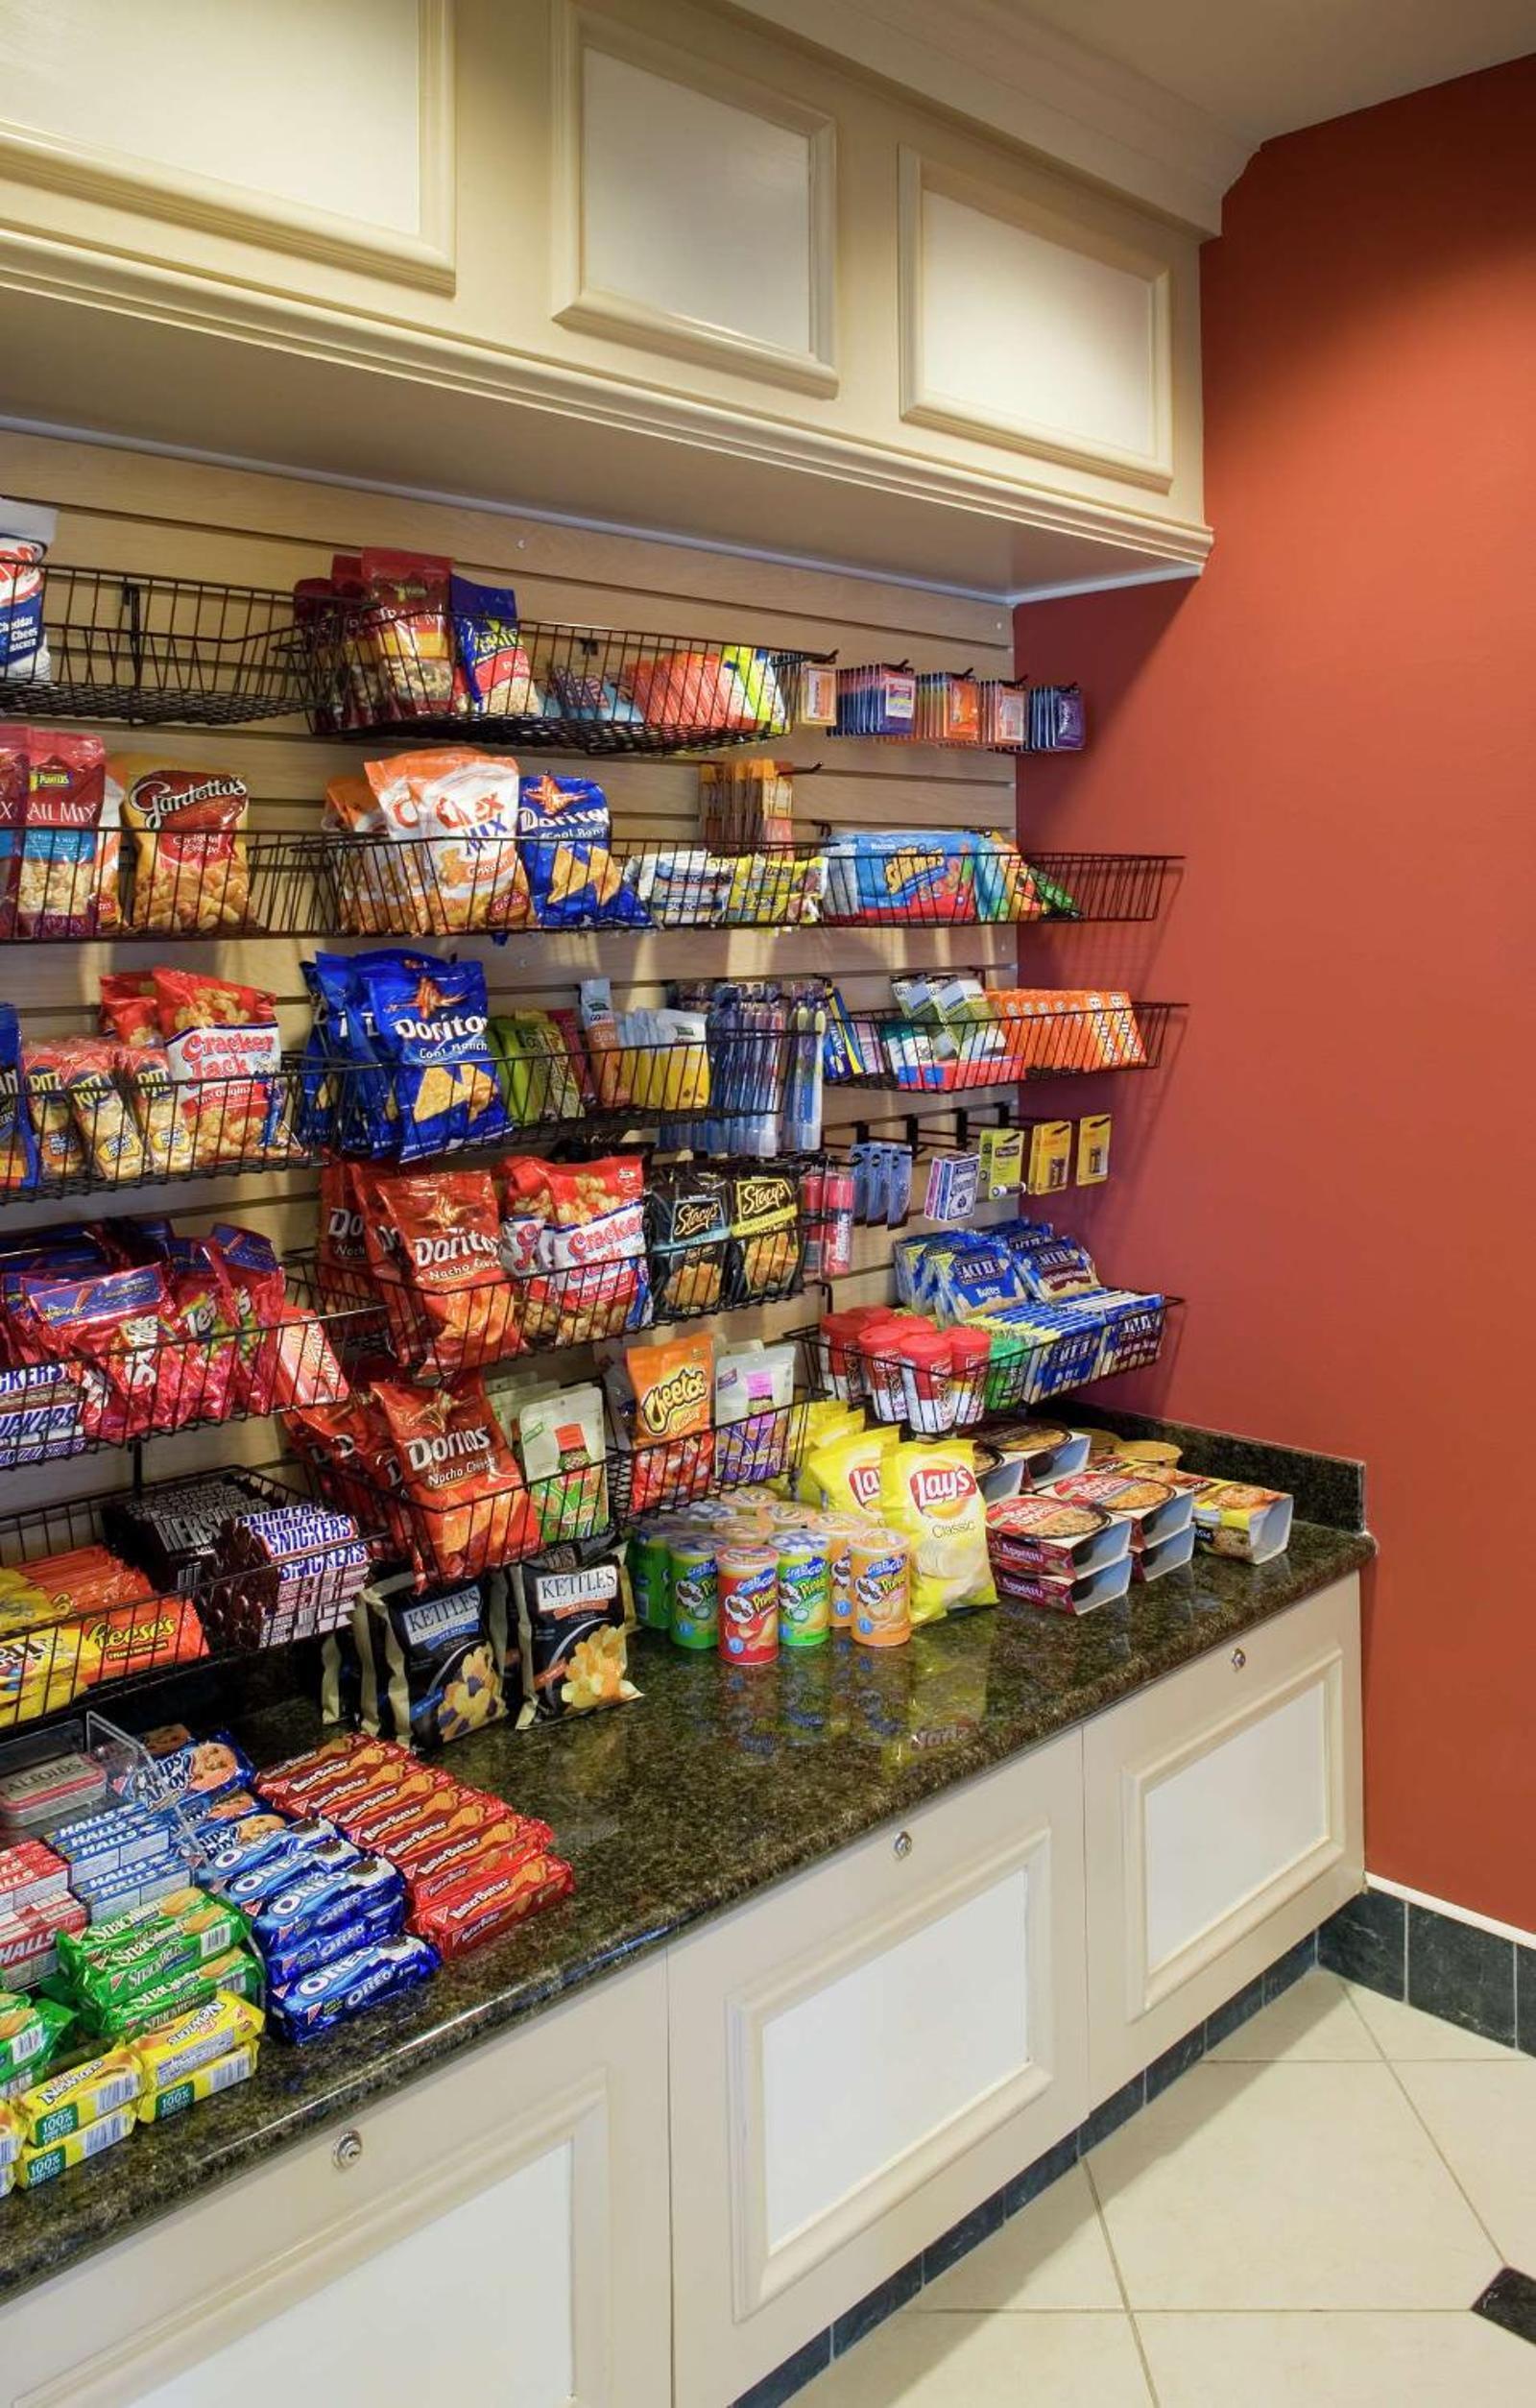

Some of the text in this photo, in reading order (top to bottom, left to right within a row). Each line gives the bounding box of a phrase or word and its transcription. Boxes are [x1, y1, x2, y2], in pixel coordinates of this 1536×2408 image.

[129, 776, 248, 831] Gardetto's
[180, 1034, 275, 1062] Cracker
[185, 1058, 251, 1089] Jack
[742, 1183, 786, 1216] Stacy's
[674, 1203, 720, 1236] Stacy's
[641, 1367, 707, 1434] Cheetos
[404, 1426, 492, 1472] Doritos
[429, 1468, 464, 1487] Nacho
[915, 1467, 972, 1507] Lay's
[267, 1516, 351, 1556] SNICKERS
[932, 1519, 976, 1539] Classic
[541, 1569, 616, 1600] KETTLES
[408, 1589, 480, 1633] KETTLES
[87, 1617, 177, 1649] Reese's
[7, 1760, 84, 1794] ALTOIDS
[0, 1927, 58, 1965] HALLS
[347, 1967, 393, 2009] OREO
[41, 2110, 75, 2132] 100%
